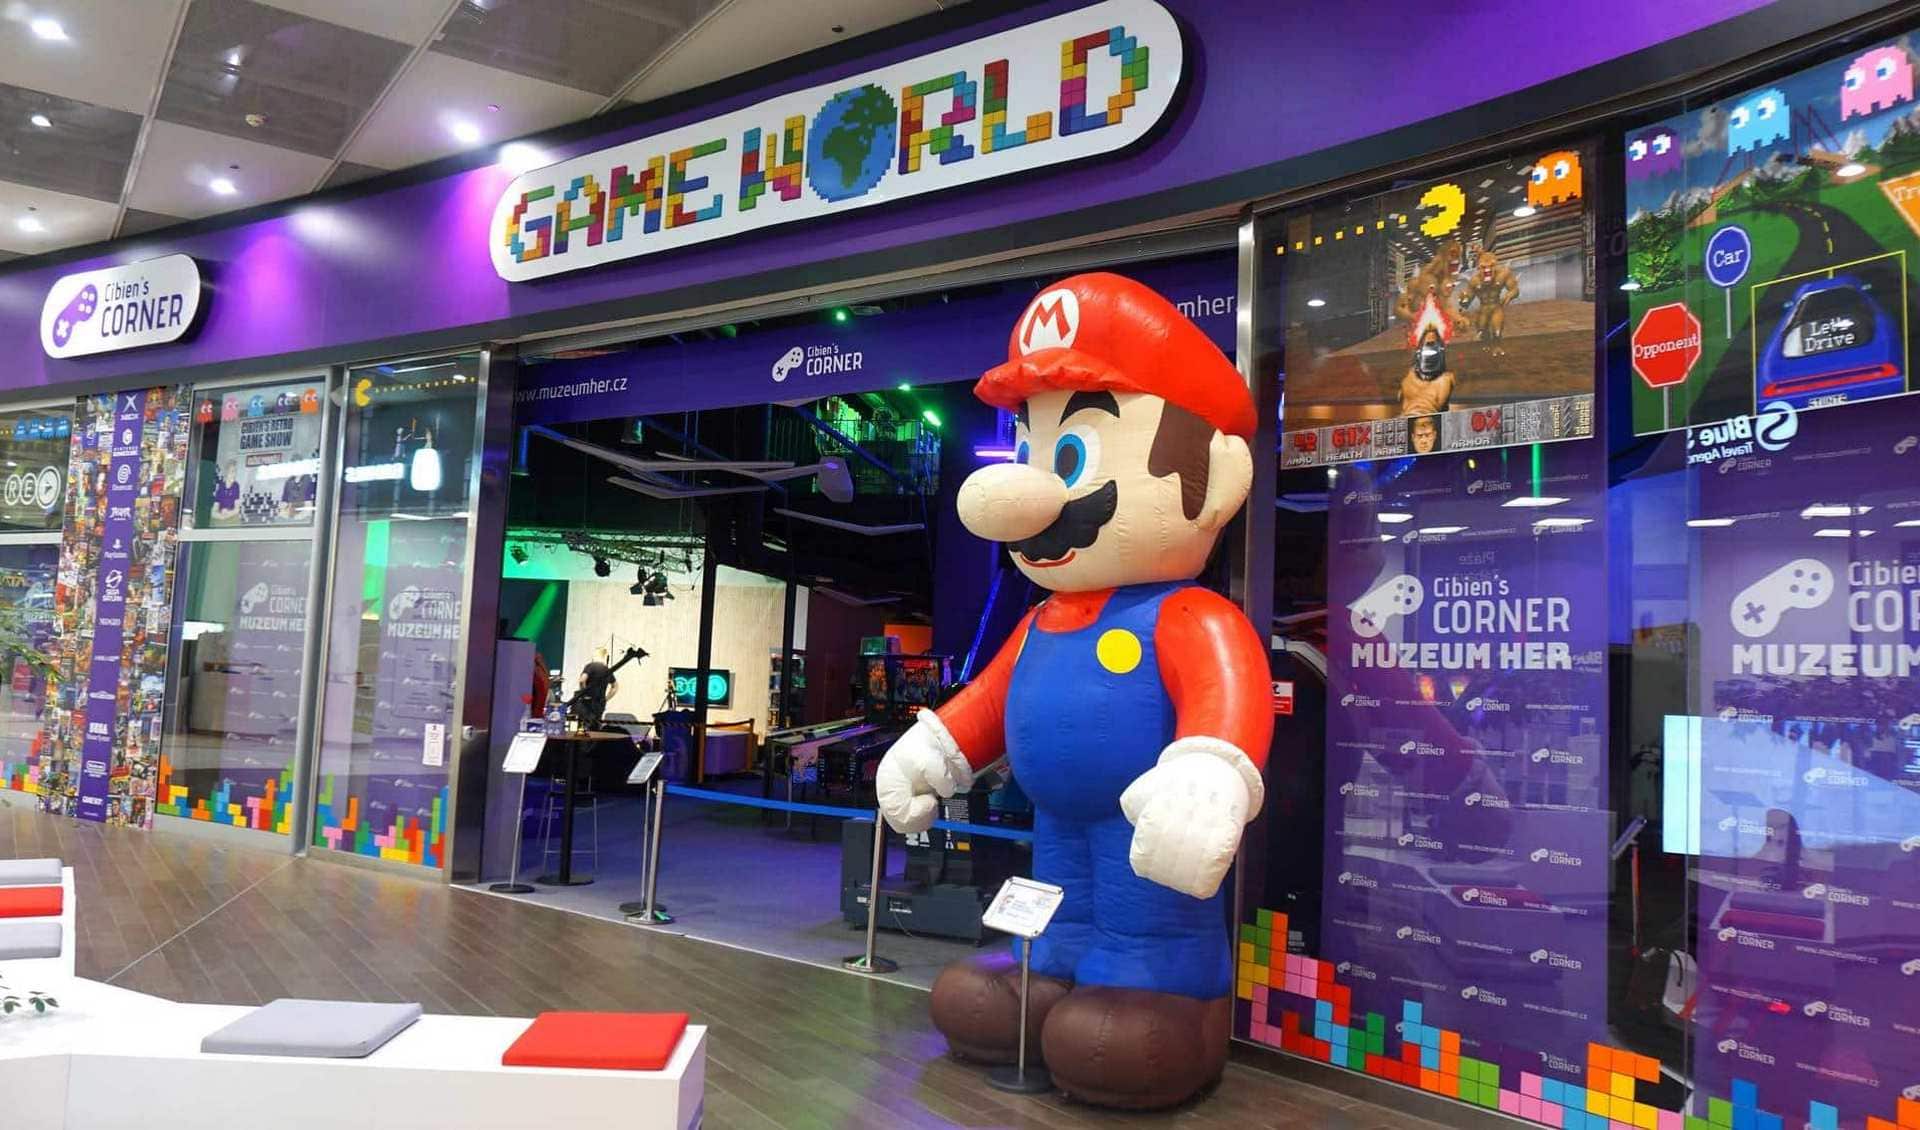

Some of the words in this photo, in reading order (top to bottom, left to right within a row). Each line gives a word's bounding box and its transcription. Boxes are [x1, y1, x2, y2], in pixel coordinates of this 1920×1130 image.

[504, 138, 727, 263] GAME
[1713, 249, 1744, 268] Car
[105, 277, 149, 302] Cibien's
[101, 294, 183, 338] CORNER
[1023, 296, 1071, 348] M
[807, 343, 839, 358] Cibien's
[1634, 336, 1699, 358] Opponent
[1804, 333, 1855, 352] Drive
[806, 352, 863, 376] CORNER
[1451, 437, 1490, 449] ARMOR
[1326, 451, 1363, 462] HEALTH
[1847, 560, 1920, 586] Cibie
[1433, 573, 1510, 599] Cibien's
[240, 615, 288, 631] MUZEUM
[1433, 597, 1571, 634] CORNER
[1351, 641, 1491, 669] MUZEUM
[1500, 640, 1573, 670] HER
[1732, 643, 1920, 678] MUZEUM
[1549, 856, 1582, 867] CORNER
[1828, 891, 1870, 907] CORNER
[1738, 935, 1775, 950] CORNER
[1549, 957, 1582, 971] CORNER
[1828, 1010, 1871, 1028] CORNER
[1739, 1048, 1775, 1065] CORNER
